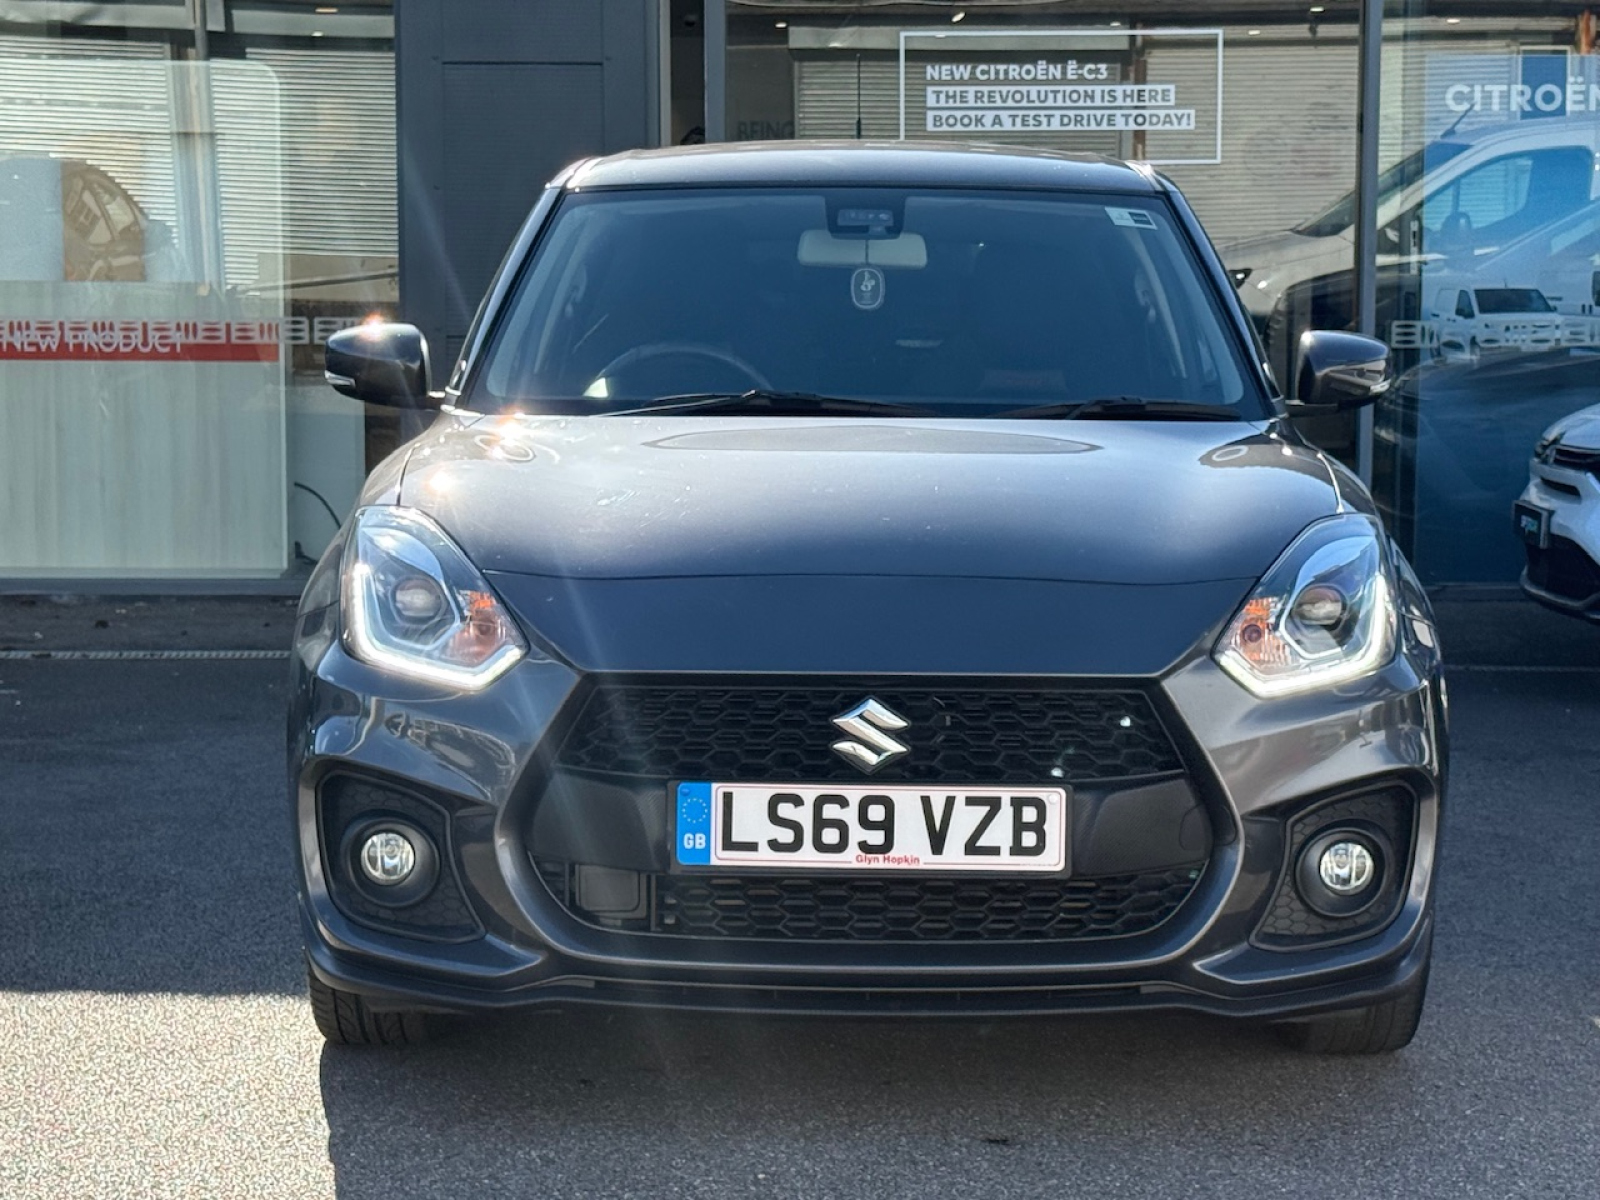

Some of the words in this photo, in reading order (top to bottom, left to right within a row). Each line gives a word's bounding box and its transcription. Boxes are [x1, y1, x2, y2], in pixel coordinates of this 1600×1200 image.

[926, 65, 972, 80] NEW
[975, 60, 1061, 80] CITROËN
[1066, 60, 1109, 80] Ë-C3
[932, 90, 969, 104] THE
[974, 89, 1095, 104] REVOLUTION
[1101, 89, 1117, 103] IS
[1122, 89, 1171, 103] HERE
[933, 114, 985, 128] BOOK
[990, 114, 1004, 128] A
[1008, 114, 1055, 127] TEST
[1060, 114, 1116, 127] DRIVE
[1121, 113, 1191, 127] TODAY!
[2, 331, 61, 353] NEW
[68, 331, 183, 354] PRODUCT
[721, 791, 895, 856] LS69
[920, 795, 1047, 857] VZB
[683, 832, 706, 850] GB
[855, 854, 880, 865] Glyn
[884, 854, 921, 866] Hopkin
